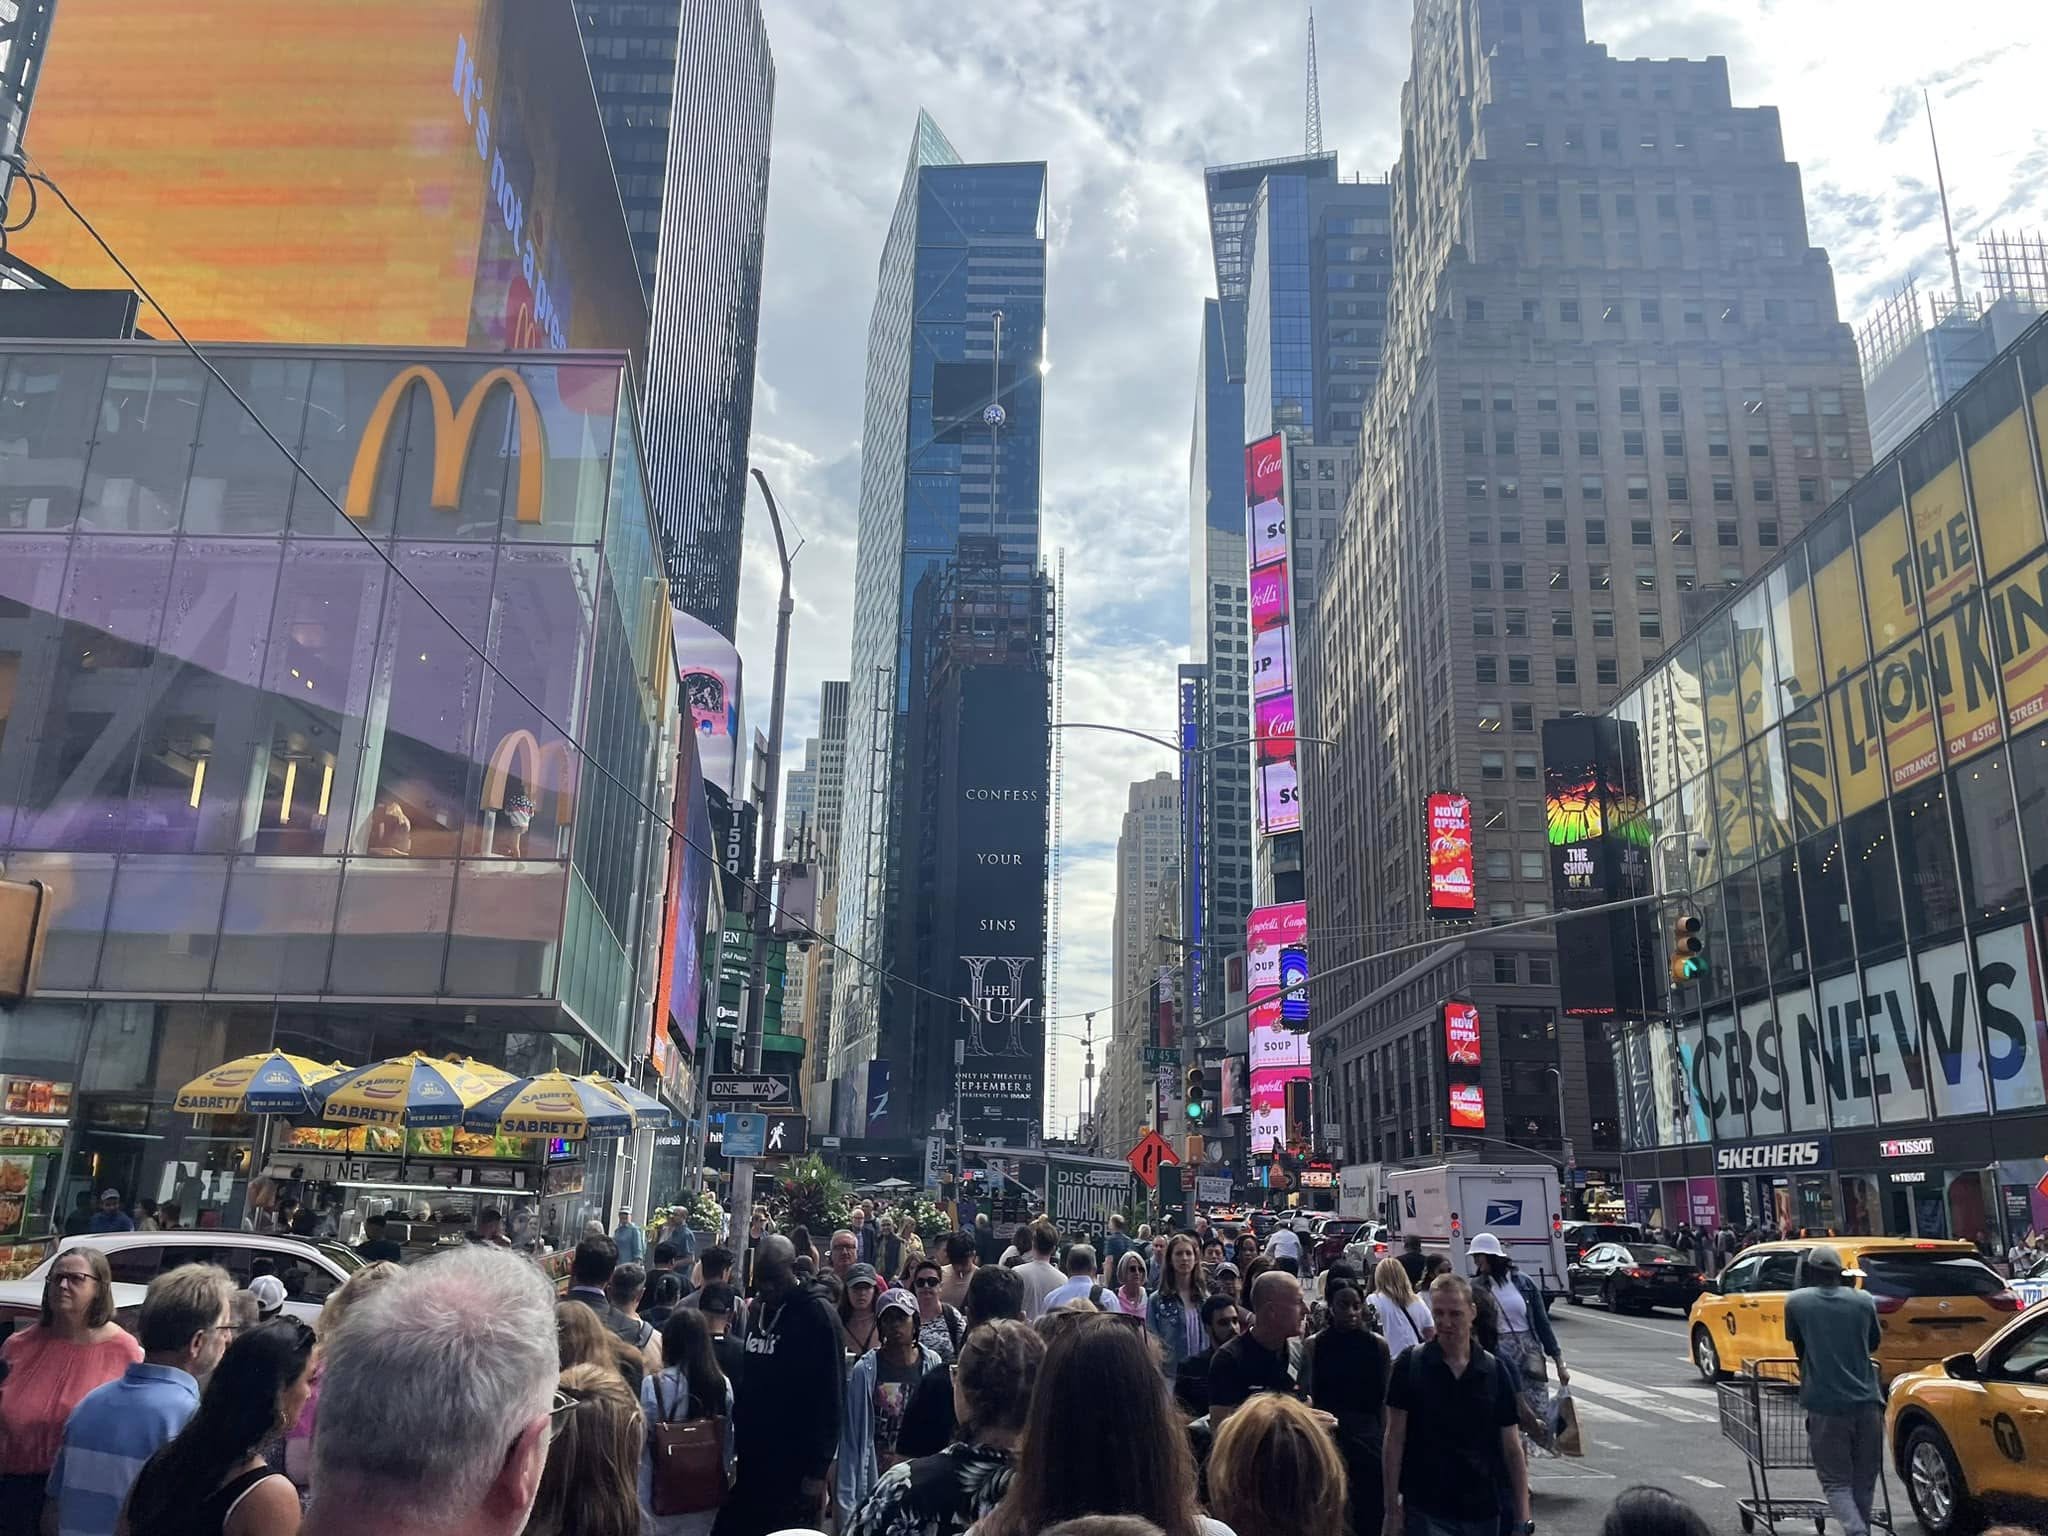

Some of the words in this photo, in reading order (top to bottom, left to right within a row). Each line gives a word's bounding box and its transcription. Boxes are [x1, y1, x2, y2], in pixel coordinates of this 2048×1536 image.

[453, 32, 489, 160] It's
[490, 146, 523, 257] not
[523, 239, 534, 288] a
[1892, 511, 1973, 606] THE
[1837, 632, 1953, 777] LION
[1895, 752, 1938, 783] ENTRANCE
[1950, 737, 1967, 753] ON
[1971, 721, 1998, 744] 45TH
[2010, 697, 2043, 725] STREET
[966, 789, 1037, 801] CONFESS
[1434, 807, 1462, 817] NOW
[1434, 818, 1465, 829] OPEN
[976, 854, 1022, 865] YOUR
[1567, 849, 1588, 861] THE
[1563, 861, 1594, 875] SHOW
[1568, 875, 1582, 888] OF
[1582, 876, 1592, 888] A
[979, 920, 1016, 931] SINS
[984, 986, 1010, 996] THE
[1450, 1017, 1474, 1029] NOW
[1263, 1040, 1292, 1052] SOUP
[1692, 1020, 1790, 1120] CBS
[1797, 961, 2027, 1105] NEWS
[1159, 1051, 1170, 1060] 45
[954, 1072, 977, 1080] ONLY
[992, 1073, 1032, 1081] THEATERS
[714, 1083, 739, 1094] ONE
[752, 1083, 780, 1094] WAY
[954, 1081, 1021, 1091] SEPTEMBER
[1025, 1082, 1032, 1091] 8
[177, 1096, 240, 1109] SABRETT
[521, 1092, 572, 1104] SABRETT
[327, 1103, 399, 1123] SABRETT
[503, 1119, 583, 1135] SABRETT
[1717, 1141, 1819, 1170] SKECHERS
